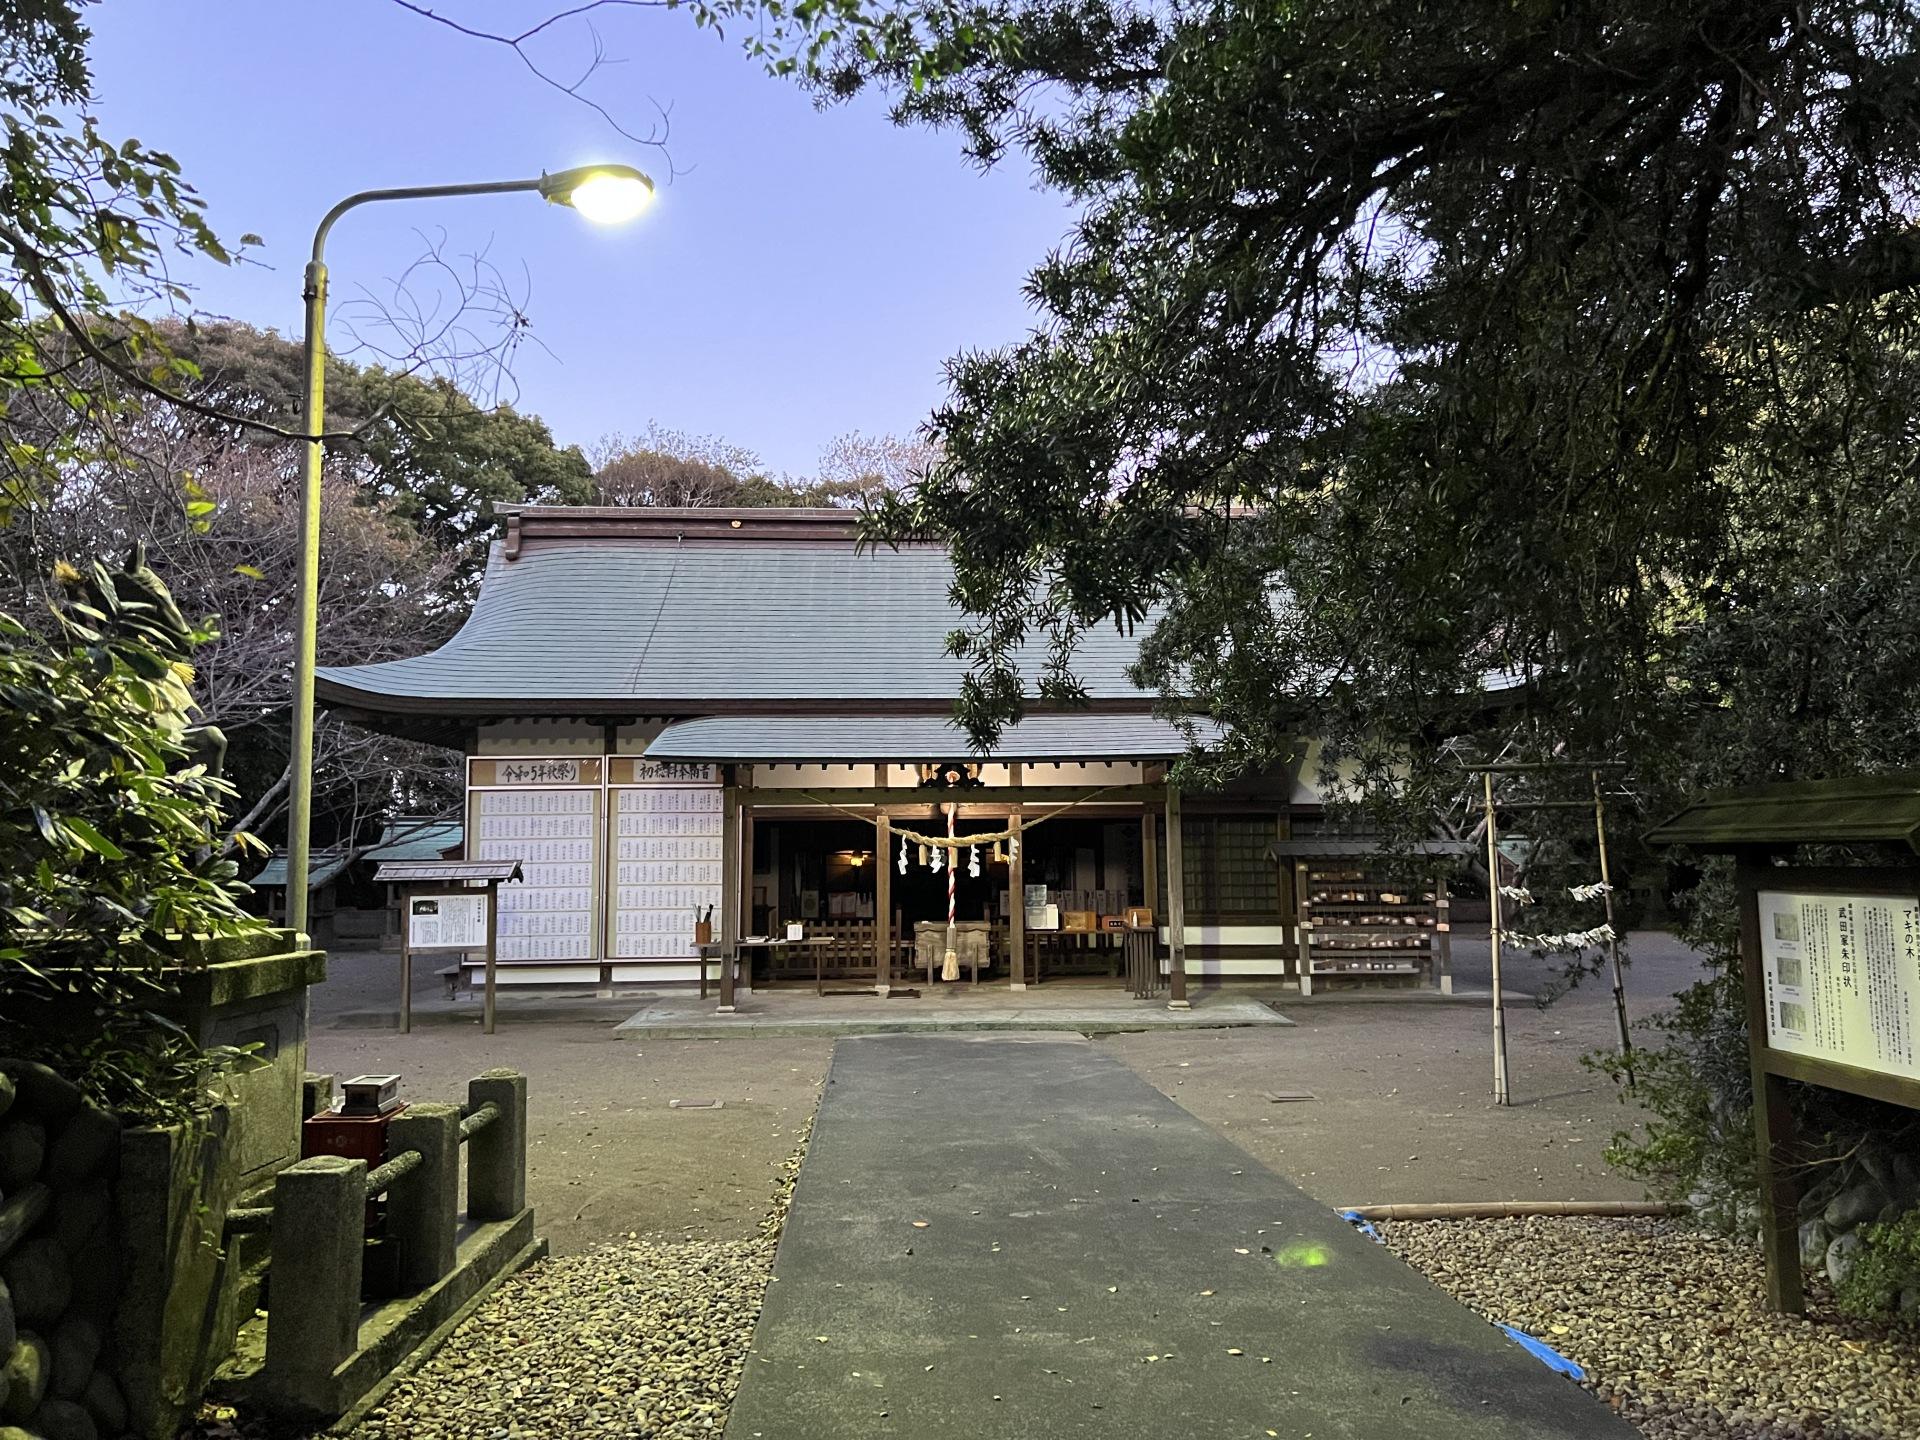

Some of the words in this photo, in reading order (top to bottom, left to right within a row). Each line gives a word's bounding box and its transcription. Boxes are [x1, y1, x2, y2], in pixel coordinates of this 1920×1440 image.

[502, 763, 576, 782] 令和5年秋祭り
[1838, 907, 1852, 988] 武田家朱印状
[1903, 910, 1915, 958] マキの木
